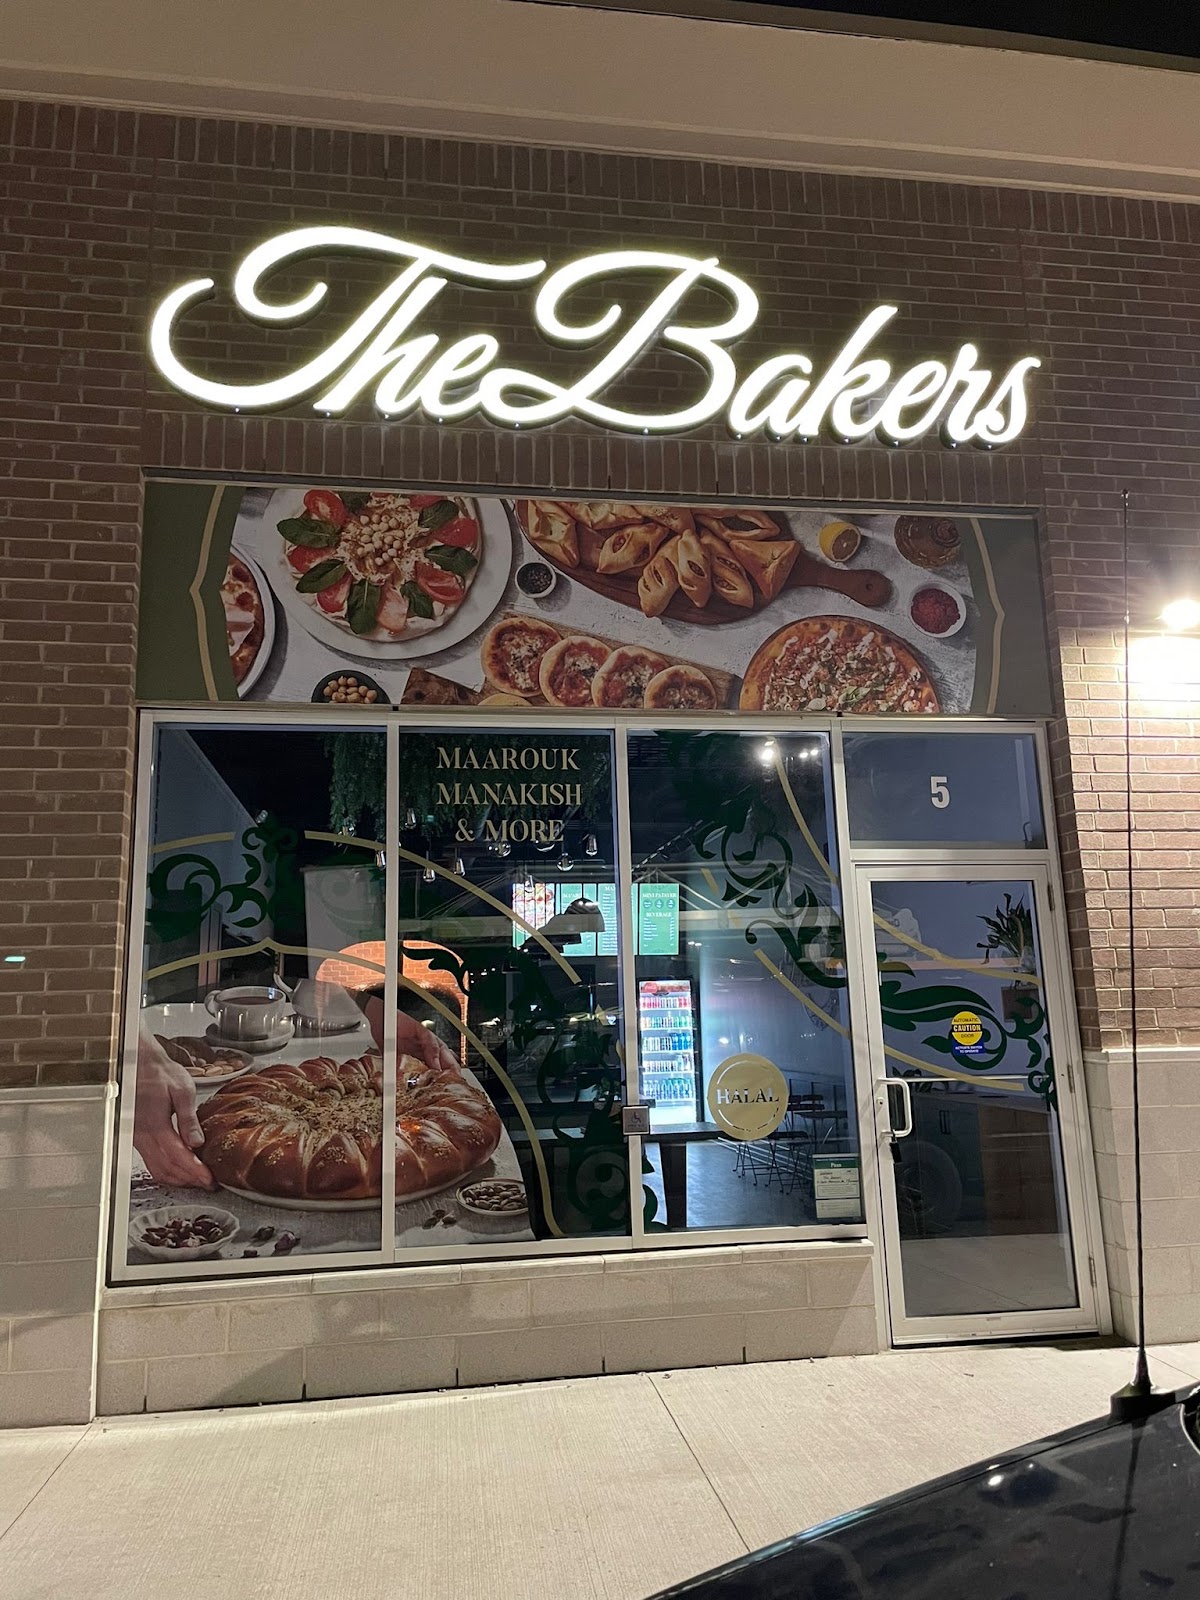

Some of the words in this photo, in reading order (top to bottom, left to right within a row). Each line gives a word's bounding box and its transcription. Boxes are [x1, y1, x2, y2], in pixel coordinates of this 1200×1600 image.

[150, 226, 546, 419] The
[478, 251, 1042, 445] Bakers
[436, 747, 581, 771] MAAROUK
[436, 783, 582, 805] MANAKISH
[930, 776, 950, 809] 5
[455, 818, 476, 842] &
[484, 819, 565, 842] MORE
[953, 1024, 981, 1032] CAUTION
[716, 1088, 780, 1105] HALAL
